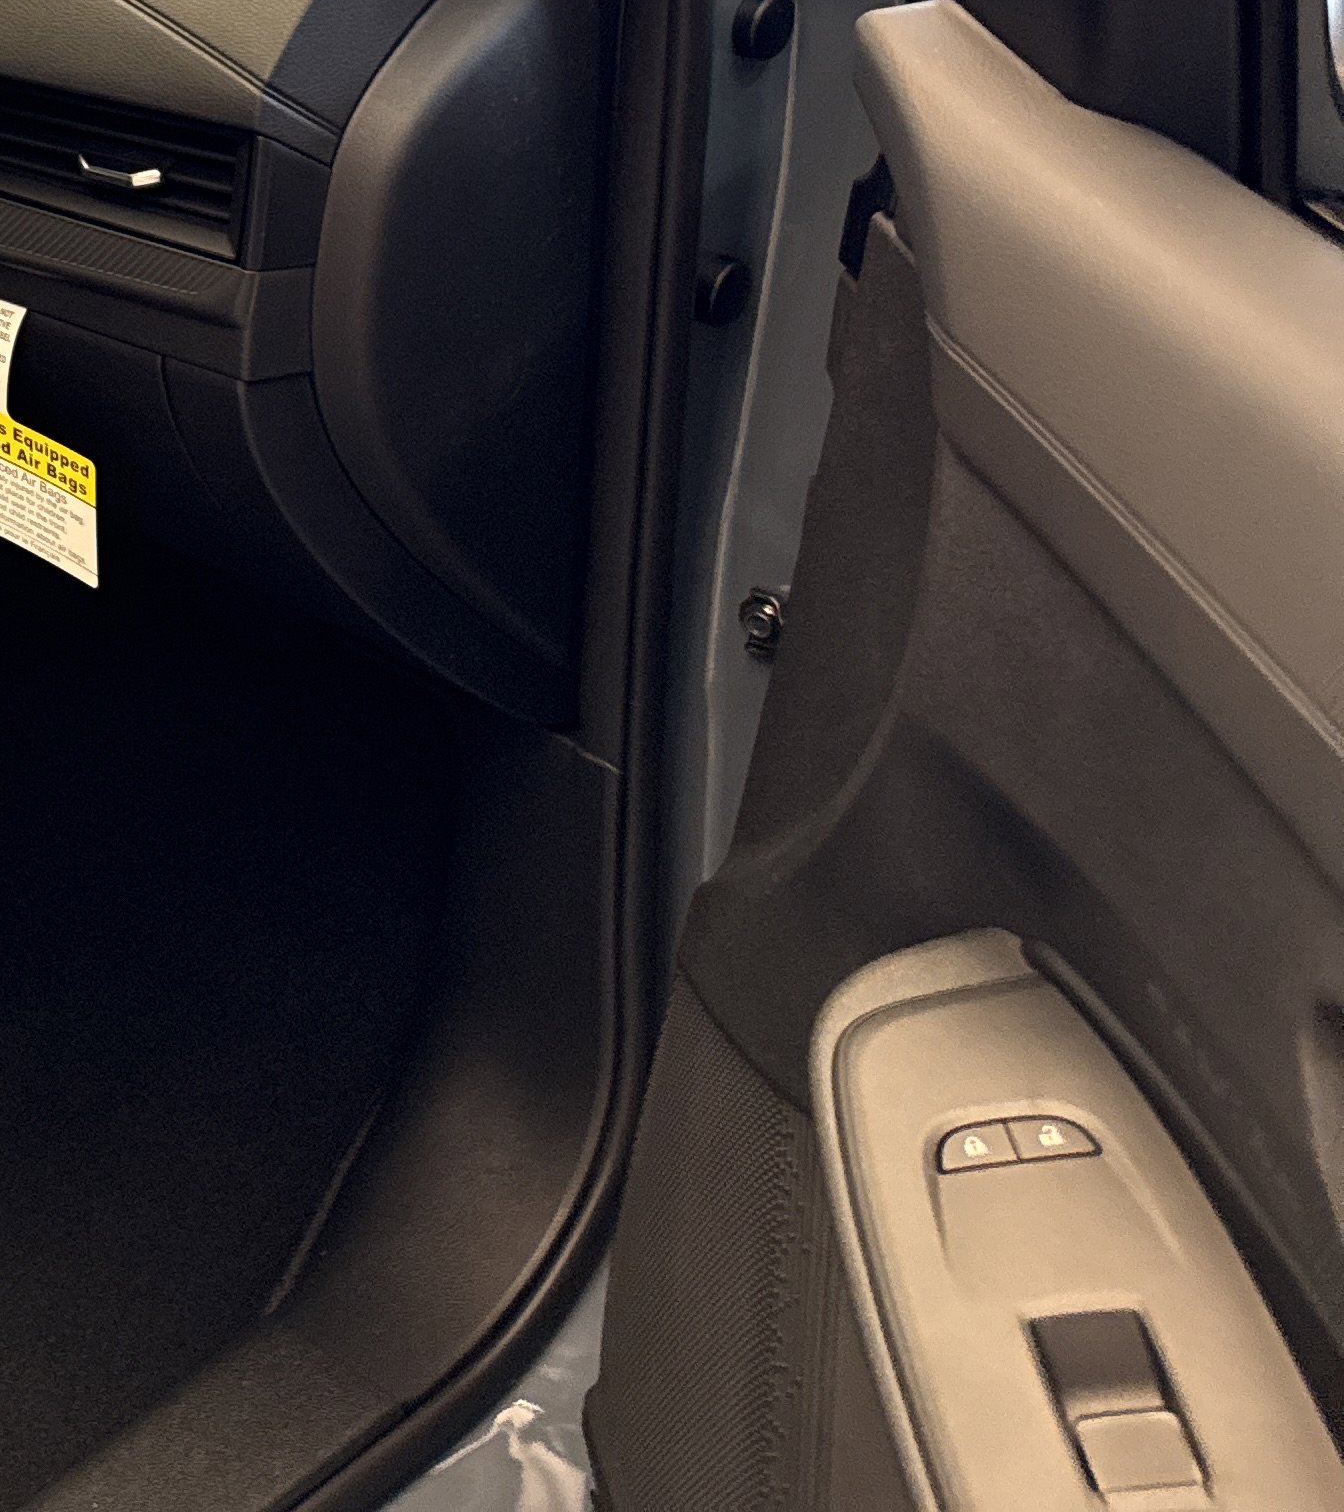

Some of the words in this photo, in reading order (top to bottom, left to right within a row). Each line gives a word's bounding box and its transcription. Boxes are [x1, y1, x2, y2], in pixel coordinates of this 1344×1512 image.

[12, 428, 89, 477] Equipped
[17, 447, 41, 471] Air
[47, 463, 87, 496] Bags
[20, 471, 36, 487] Air
[39, 480, 67, 506] Bags
